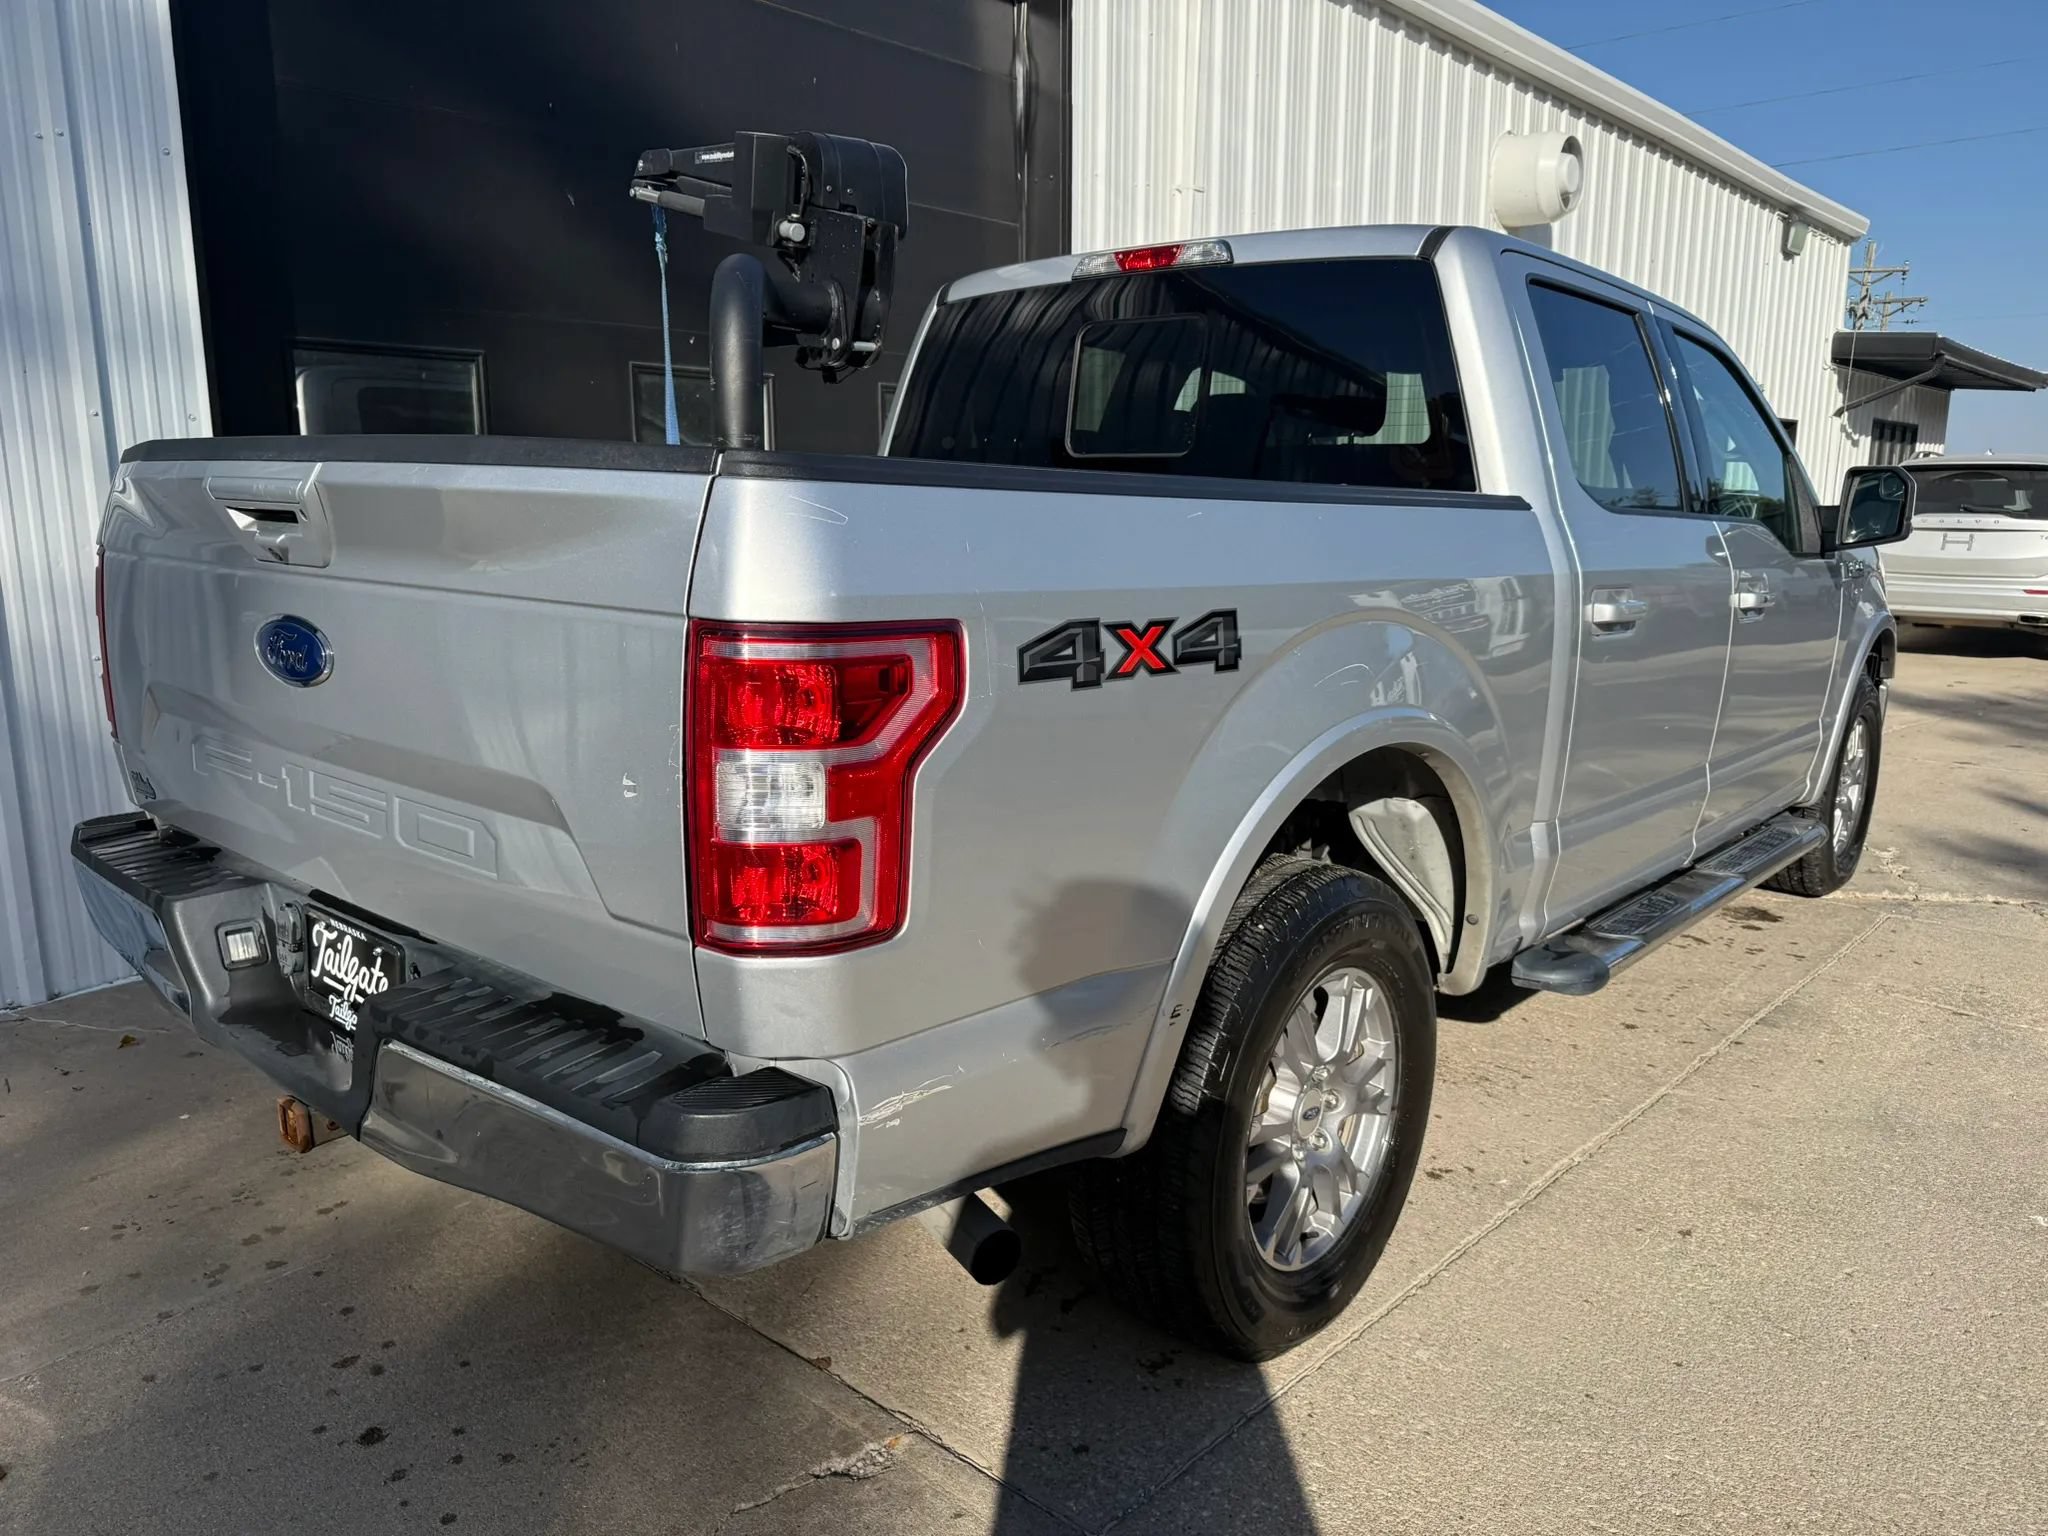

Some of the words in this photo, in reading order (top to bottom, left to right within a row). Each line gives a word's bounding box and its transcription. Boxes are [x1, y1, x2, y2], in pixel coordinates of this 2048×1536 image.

[266, 628, 308, 672] Ford
[192, 734, 498, 880] F-150
[329, 918, 367, 942] NEBRASKA
[310, 921, 389, 1003] Tailgate
